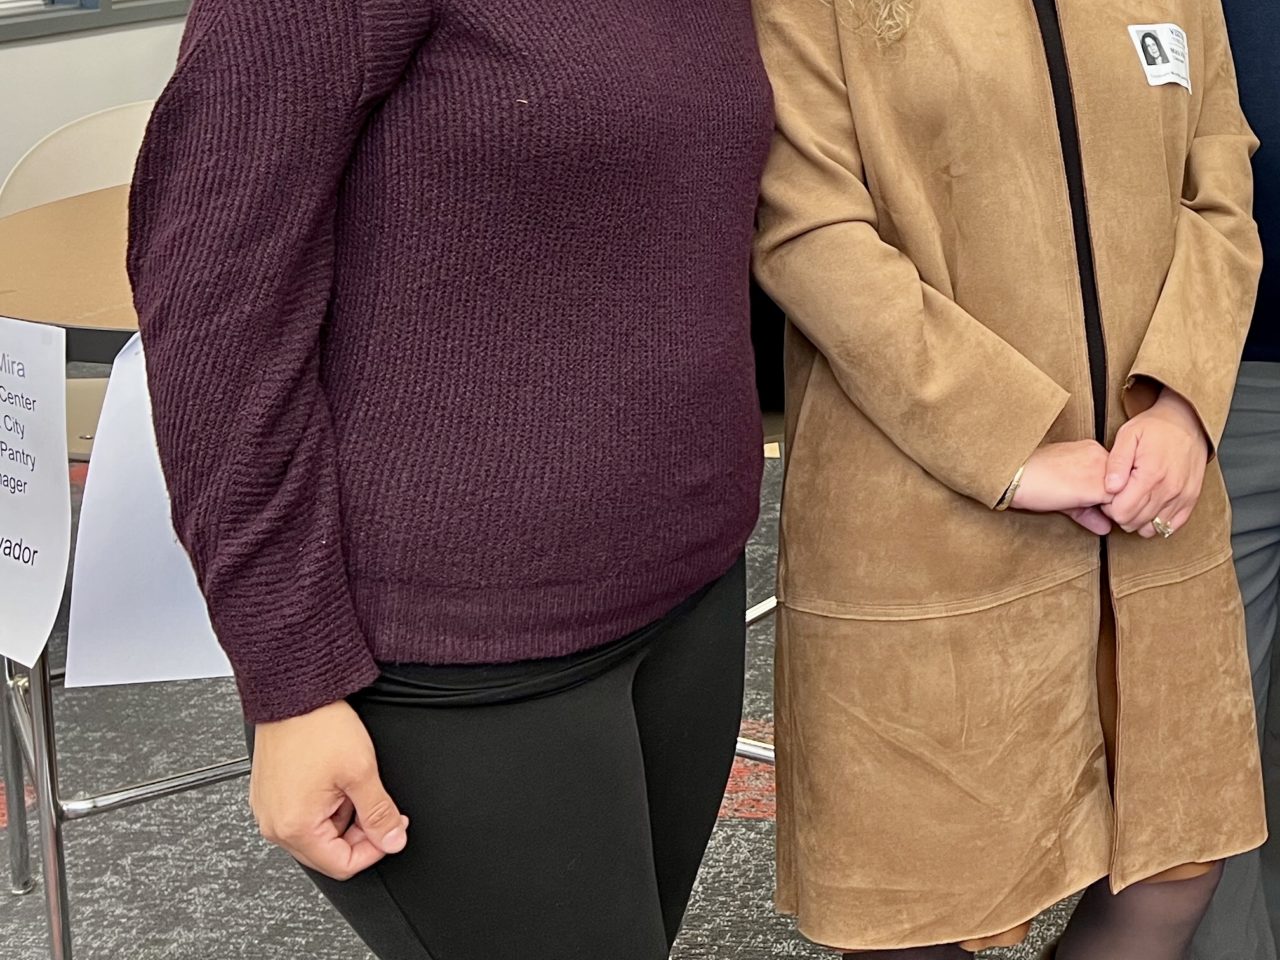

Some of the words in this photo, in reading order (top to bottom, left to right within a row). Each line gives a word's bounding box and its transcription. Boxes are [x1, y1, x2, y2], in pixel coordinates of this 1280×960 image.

[0, 385, 36, 412] Center
[4, 414, 25, 439] City
[0, 440, 36, 471] Pantry
